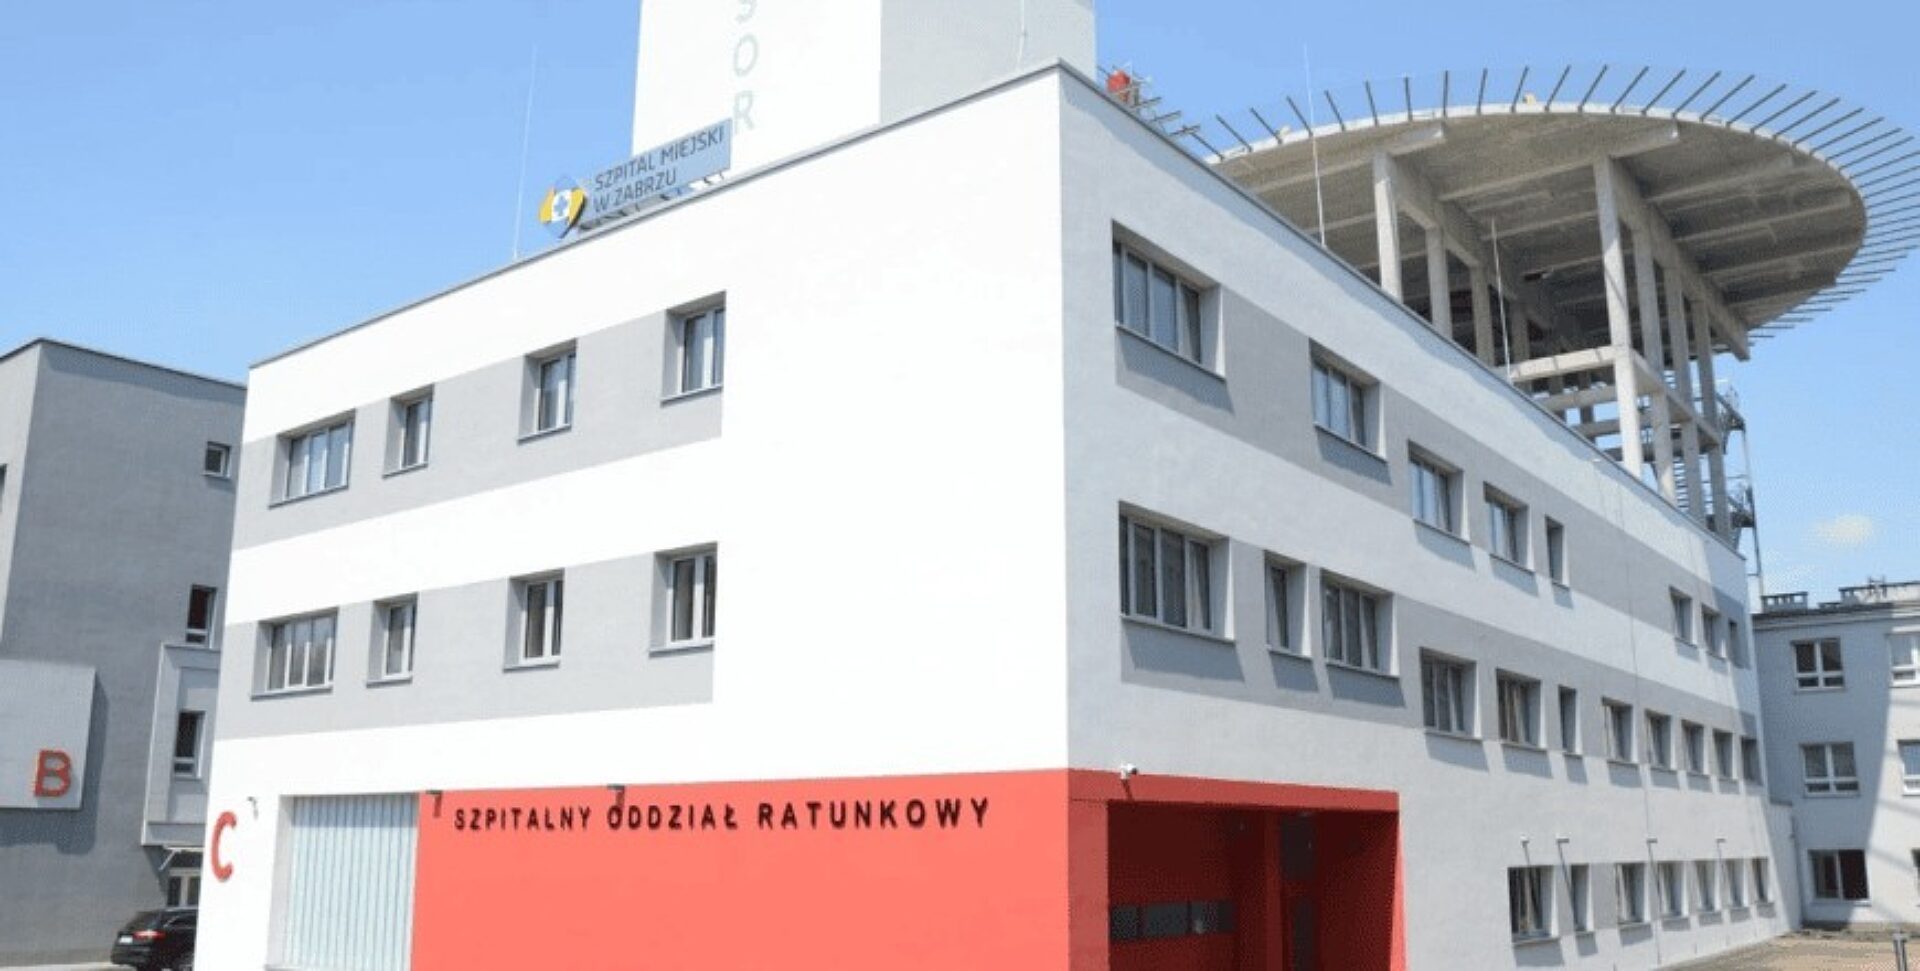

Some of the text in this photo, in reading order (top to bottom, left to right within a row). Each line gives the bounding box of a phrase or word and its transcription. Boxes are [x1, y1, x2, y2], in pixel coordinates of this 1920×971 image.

[595, 127, 725, 191] SZPITAL MIEJSKI
[593, 170, 677, 213] W ZABRZU
[34, 749, 72, 797] B
[454, 797, 990, 831] SZPITALNY ODDZIAŁ RATUNKOWY
[211, 811, 237, 882] C
